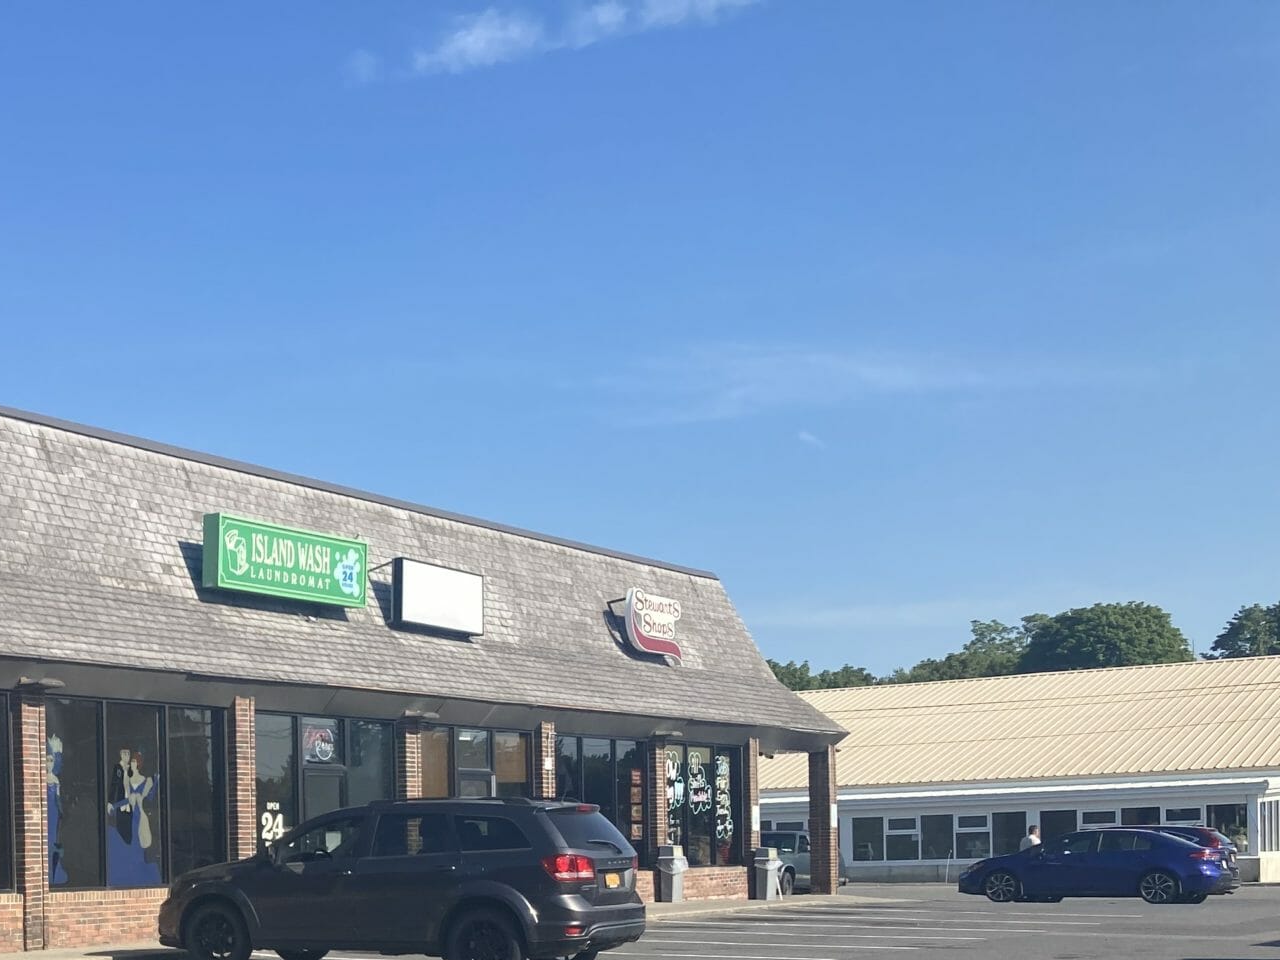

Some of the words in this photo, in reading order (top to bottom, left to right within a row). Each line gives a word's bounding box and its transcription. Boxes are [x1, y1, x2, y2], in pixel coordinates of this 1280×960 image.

[251, 533, 295, 568] ISLAND
[297, 542, 331, 575] WASH
[250, 565, 331, 590] LAUNDROMAT
[342, 571, 353, 582] 24
[643, 613, 673, 637] Shops
[261, 811, 284, 841] 24
